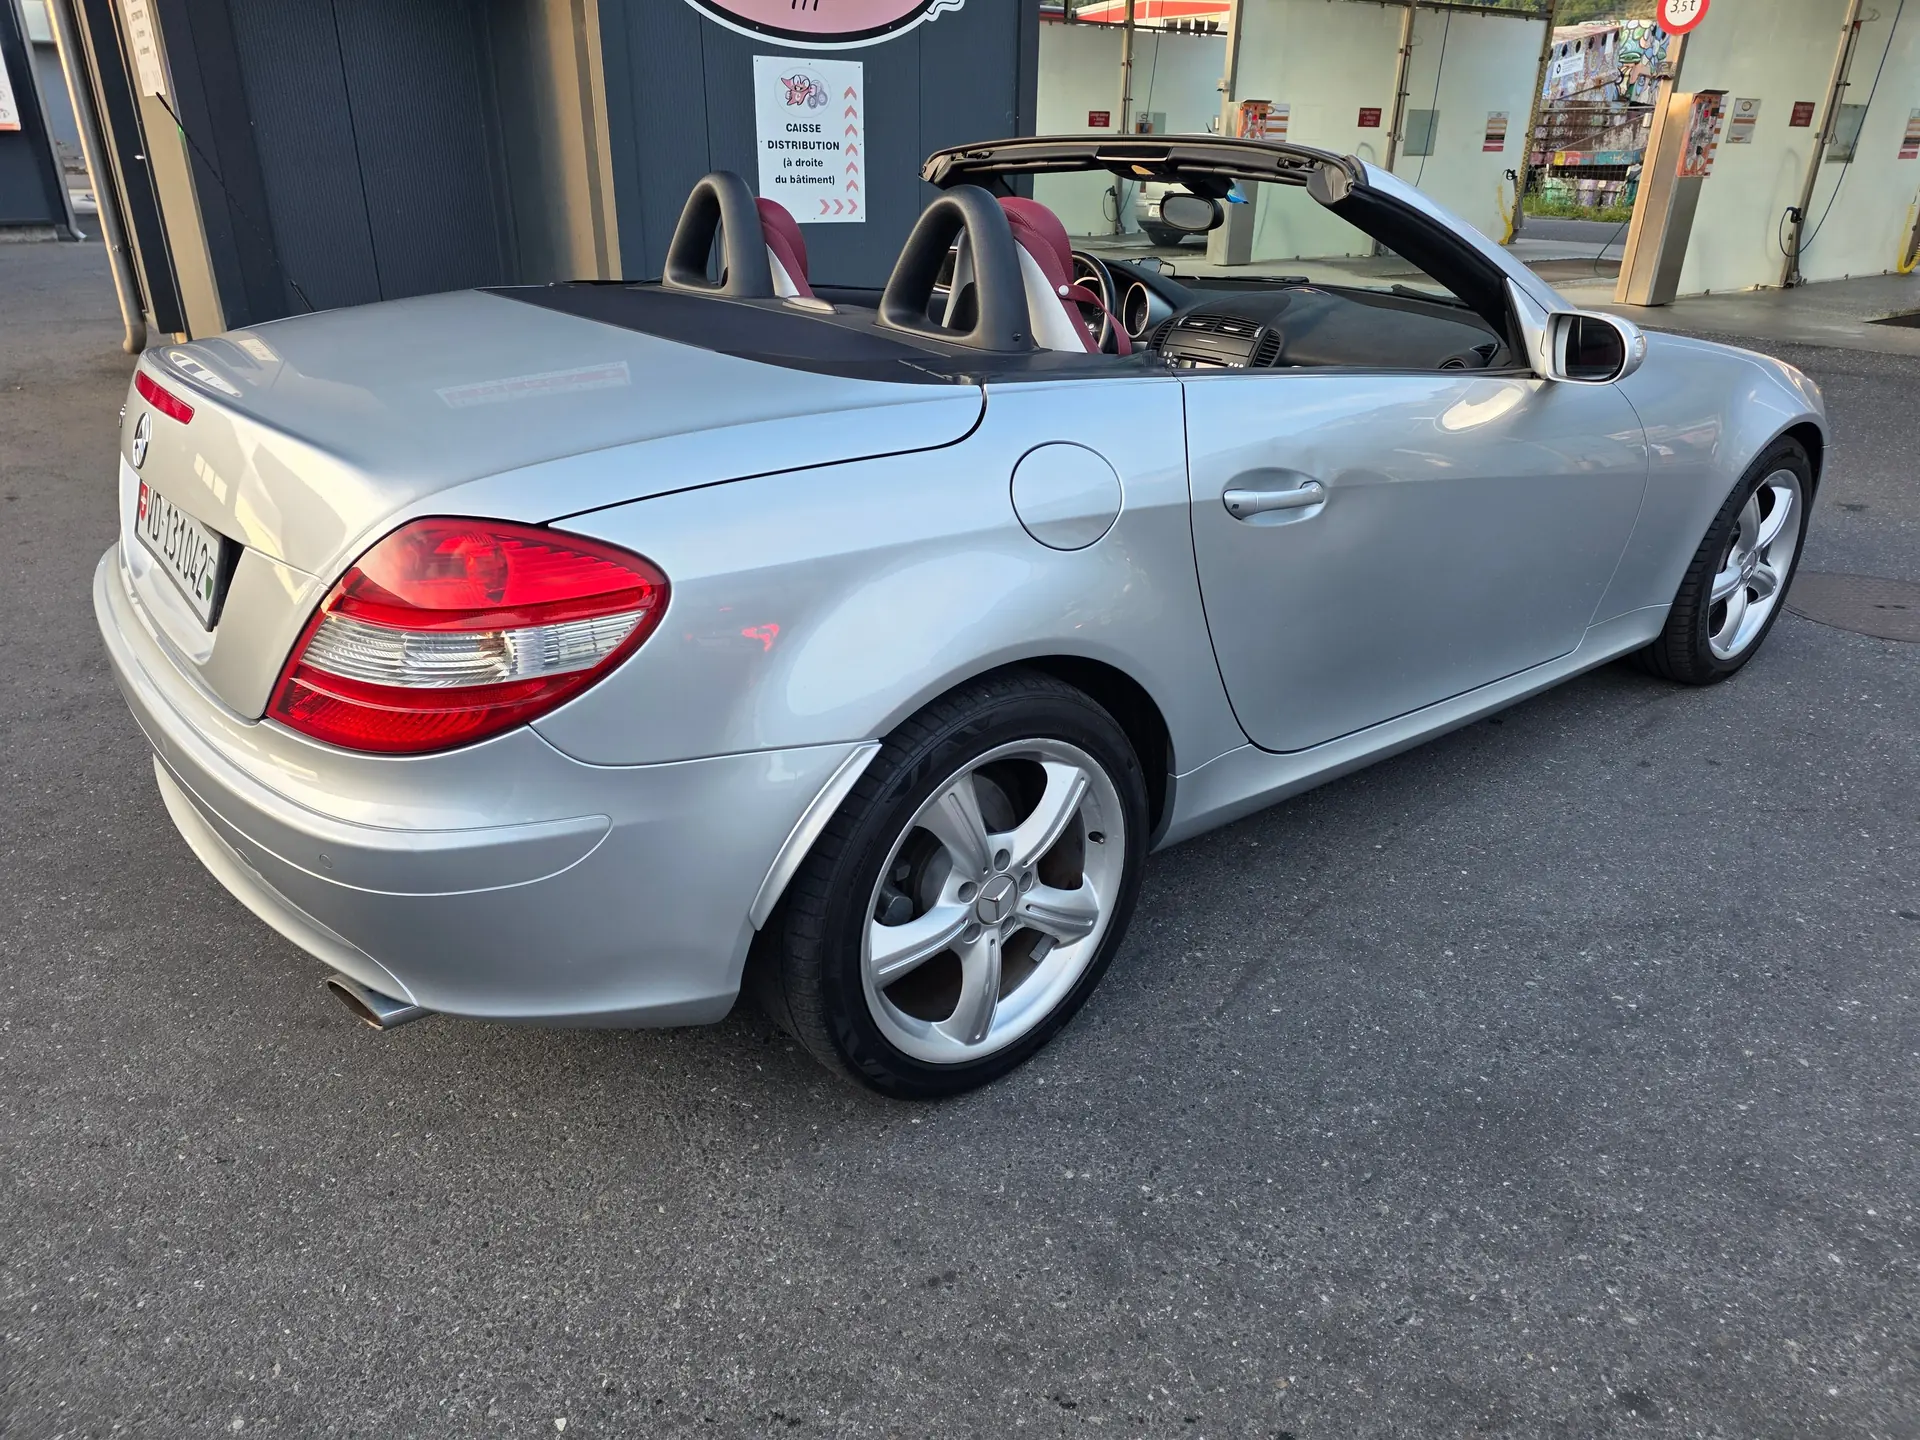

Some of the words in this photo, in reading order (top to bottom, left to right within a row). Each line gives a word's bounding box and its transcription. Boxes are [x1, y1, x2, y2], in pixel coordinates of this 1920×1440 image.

[1670, 0, 1688, 14] 3,5
[1690, 0, 1696, 11] t
[785, 123, 822, 133] CAISSE
[767, 140, 840, 151] DISTRIBUTION
[783, 157, 793, 168] (à
[795, 157, 824, 168] droite
[775, 174, 787, 184] du
[789, 174, 836, 186] bâtiment)
